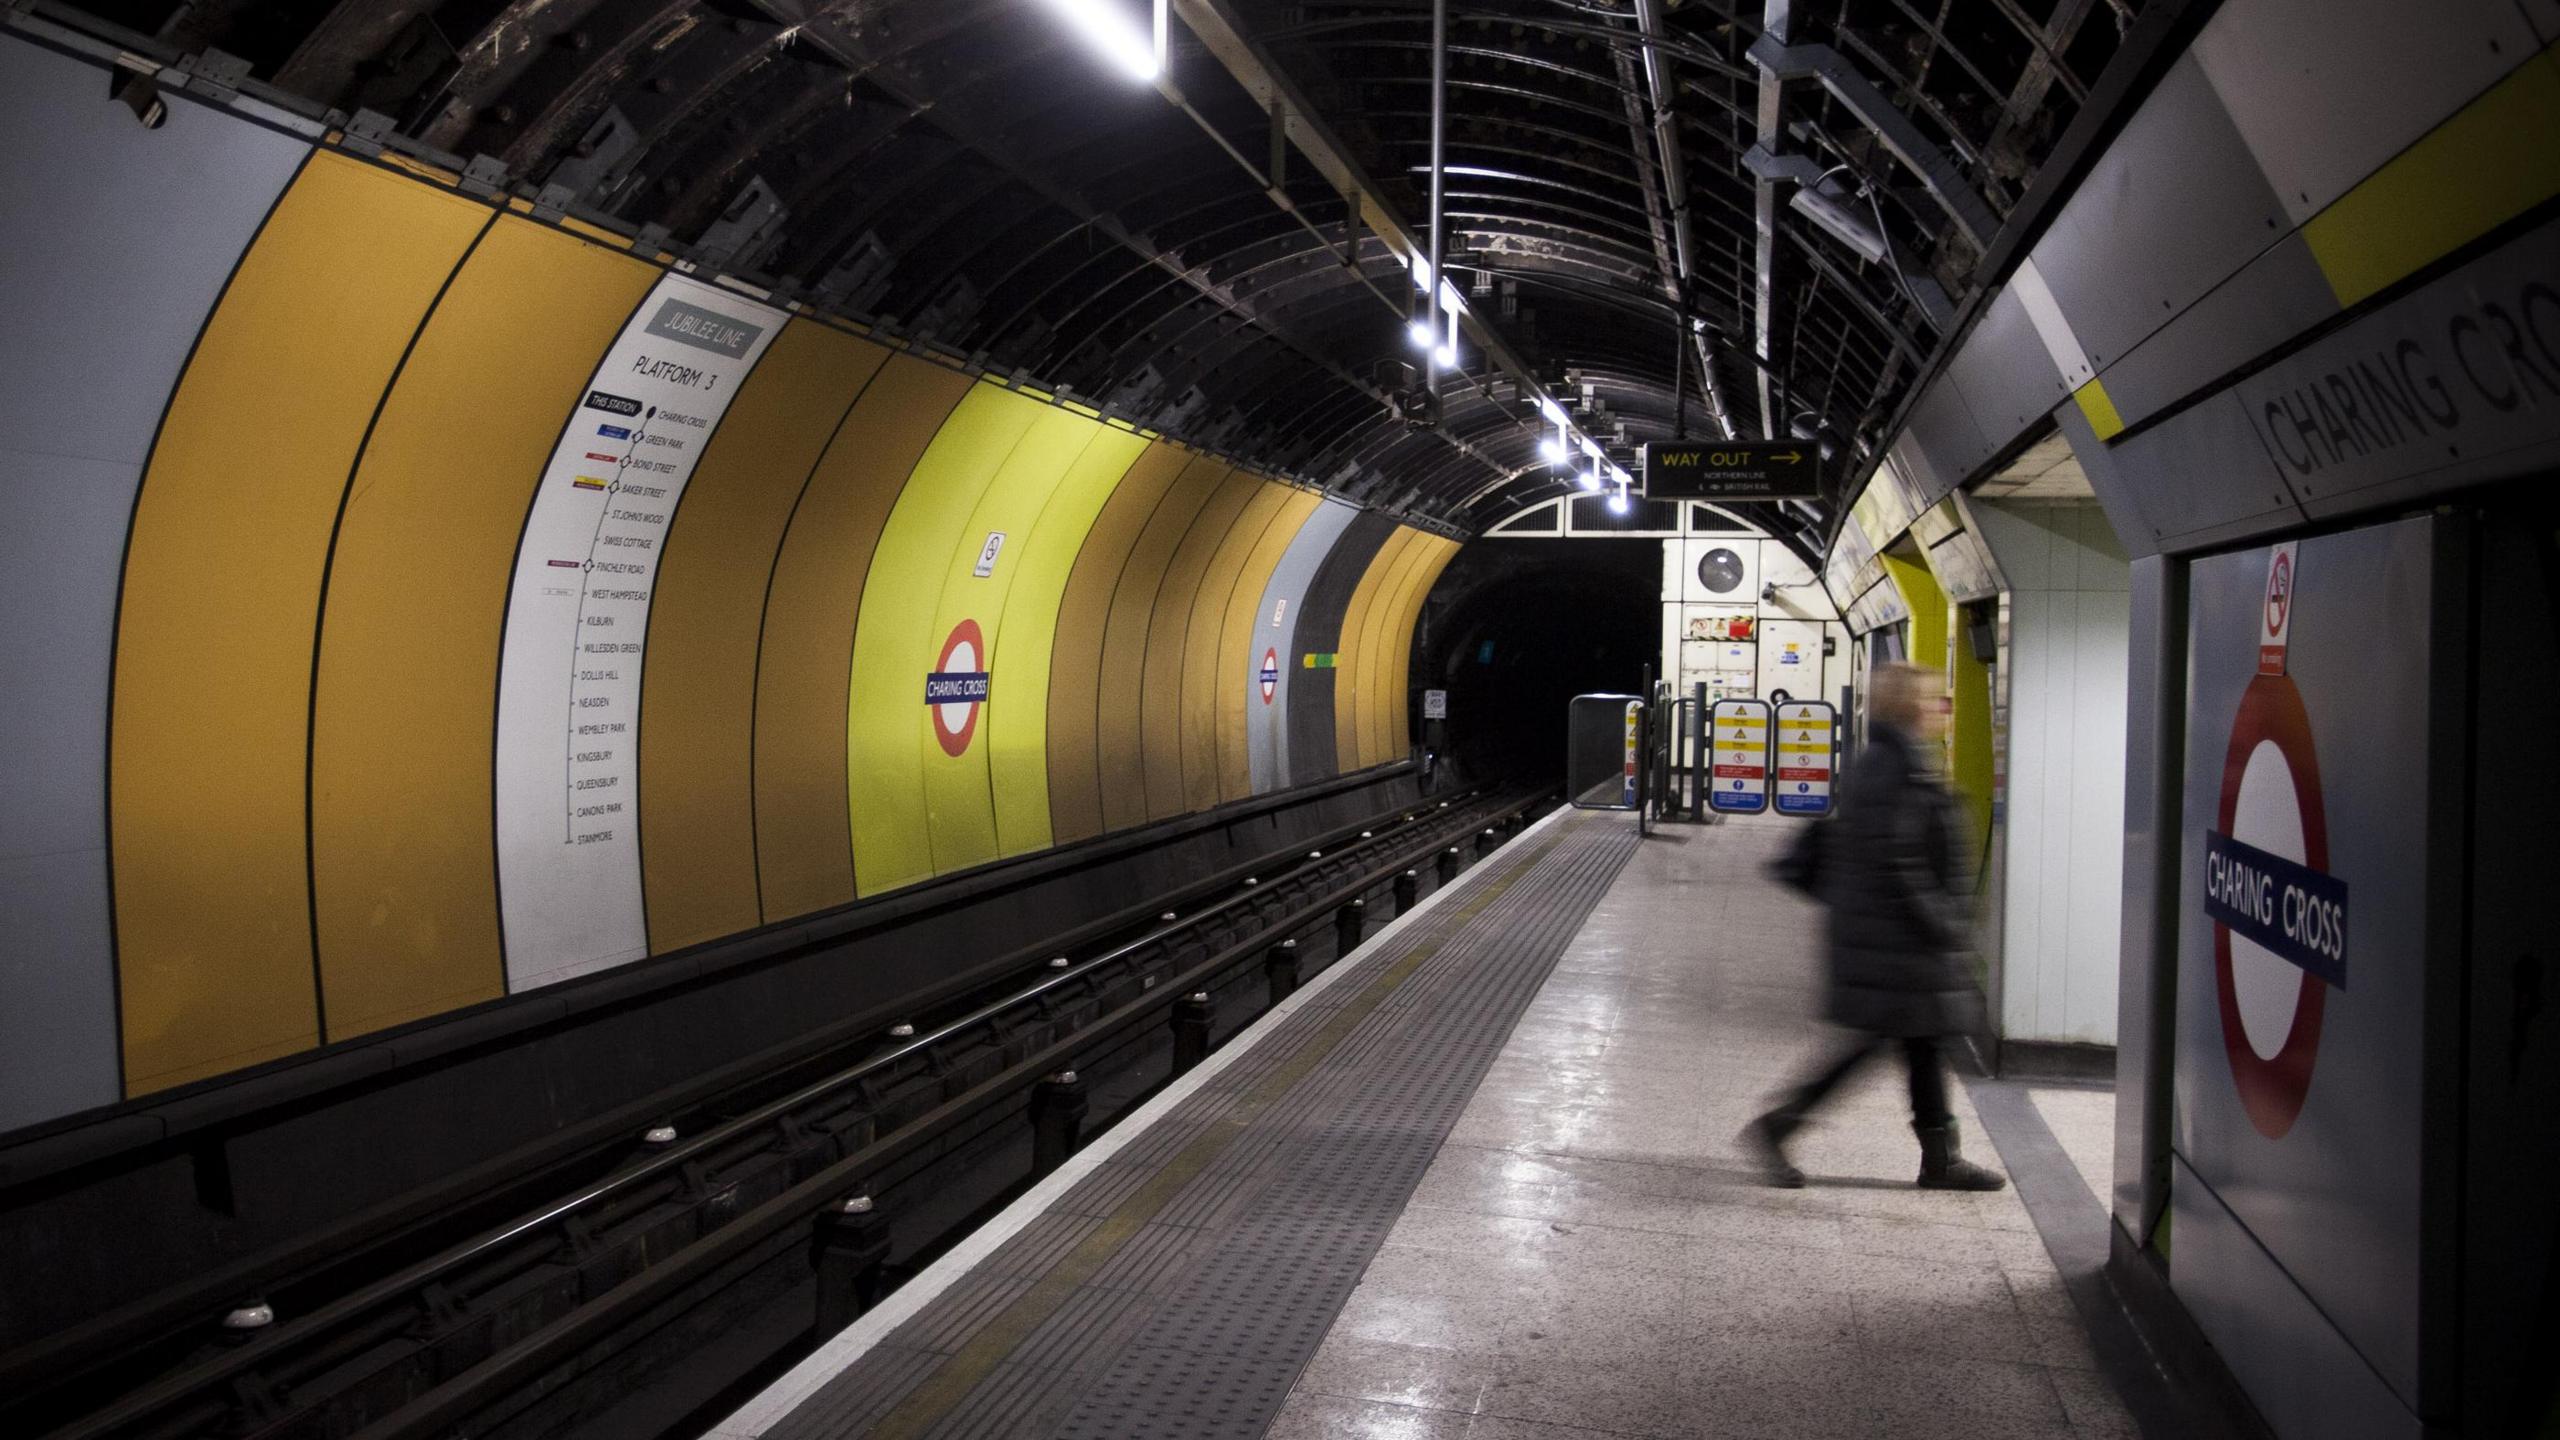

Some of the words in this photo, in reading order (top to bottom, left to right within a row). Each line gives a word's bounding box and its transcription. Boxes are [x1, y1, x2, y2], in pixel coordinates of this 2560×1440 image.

[664, 312, 718, 340] JUBILEE
[714, 324, 746, 348] LINE
[632, 356, 703, 387] PLATFORM
[705, 374, 717, 390] 3
[591, 394, 608, 407] THIS
[606, 399, 637, 413] STATION
[2264, 338, 2460, 475] CHARING
[658, 410, 687, 424] CHARING
[687, 417, 708, 429] CROSS
[645, 434, 667, 446] GREEN
[667, 438, 684, 449] PARK
[1662, 453, 1701, 466] WAY
[1711, 452, 1752, 466] OUT
[632, 459, 653, 471] BOND
[652, 463, 677, 474] STREET
[621, 484, 644, 495] BAKER
[643, 487, 667, 498] STREET
[643, 513, 665, 524] WOOD
[603, 535, 623, 546] SWISS
[622, 537, 653, 549] COTTAGE
[596, 562, 628, 573] FINCHLEY
[627, 564, 646, 574] ROAD
[592, 589, 610, 599] WEST
[610, 590, 648, 601] HAMPSTEAD
[586, 616, 615, 626] KILBURN
[584, 643, 619, 653] WILLESDEN
[620, 643, 641, 653] GREEN
[581, 670, 604, 680] DOLLIS
[605, 670, 619, 680] HILL
[928, 680, 963, 697] CHARING
[963, 680, 987, 695] CROSS
[580, 697, 609, 708] NEASDEN
[578, 724, 609, 735] WEMBLEY
[610, 722, 626, 733] PARK
[576, 750, 613, 762] KINGSBURY
[576, 777, 618, 790] QUEENSBURY
[577, 805, 604, 817] CANONS
[606, 803, 623, 813] PARK
[577, 830, 613, 845] STANMORE
[2206, 851, 2273, 926] CHARING
[2283, 884, 2343, 961] CROSS
